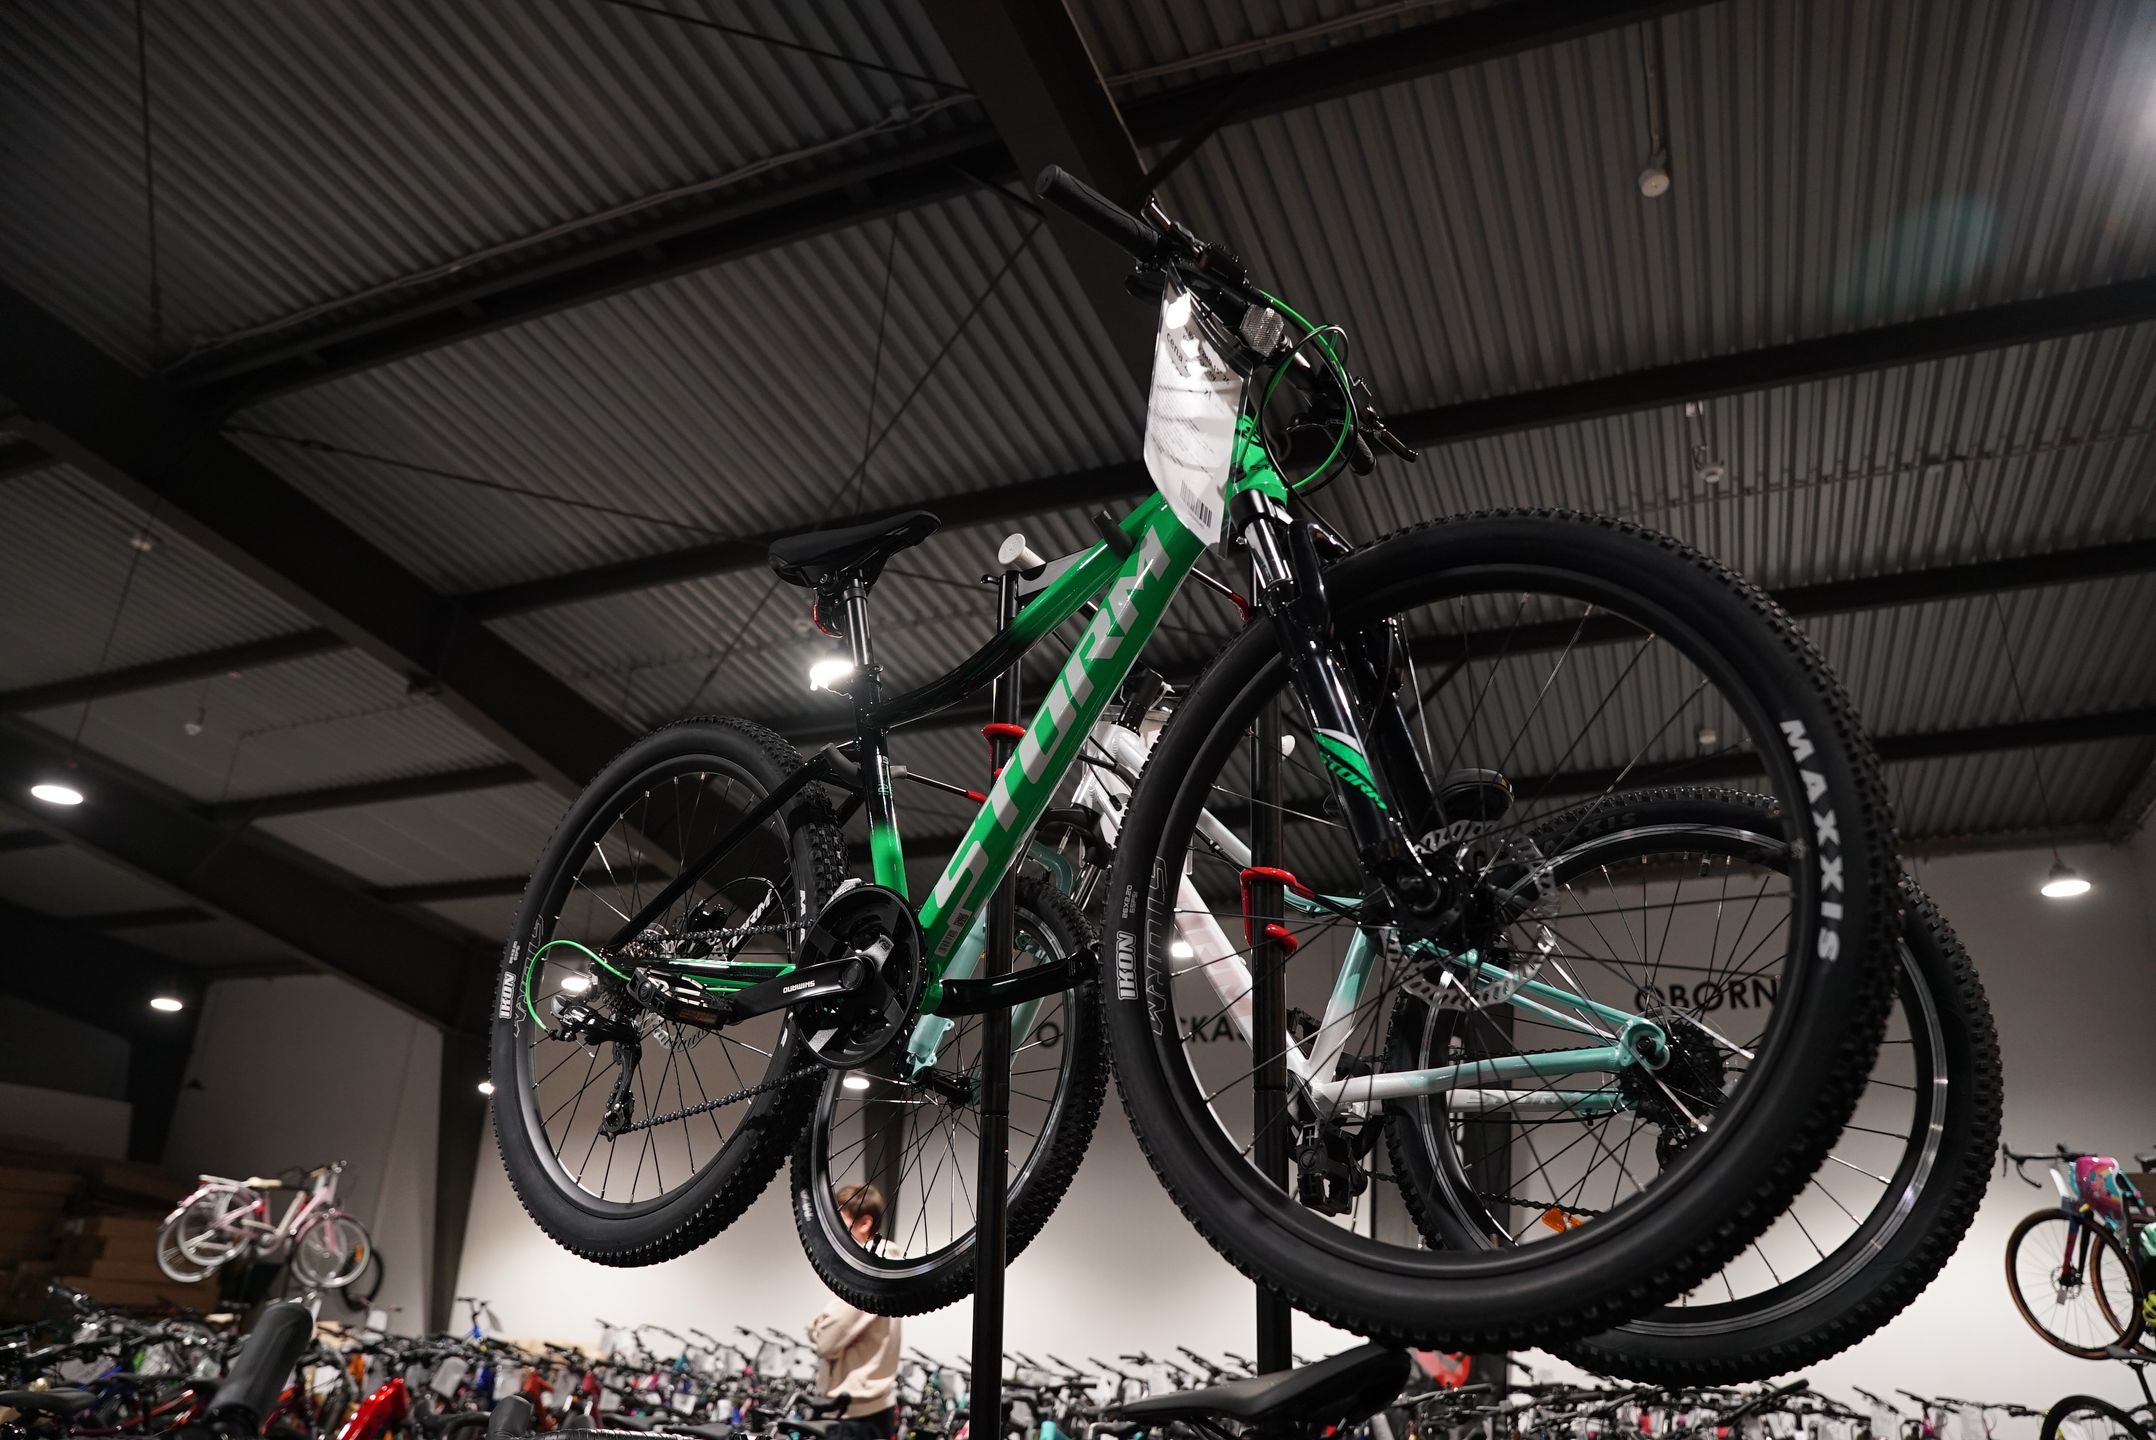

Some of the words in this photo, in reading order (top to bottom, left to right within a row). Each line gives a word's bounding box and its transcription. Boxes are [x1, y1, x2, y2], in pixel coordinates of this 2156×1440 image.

[934, 524, 1172, 921] STORM
[1779, 719, 1844, 962] MAXXIS
[499, 971, 517, 1019] IKON
[782, 979, 816, 994] SHIMANO
[1116, 930, 1138, 1000] IKON
